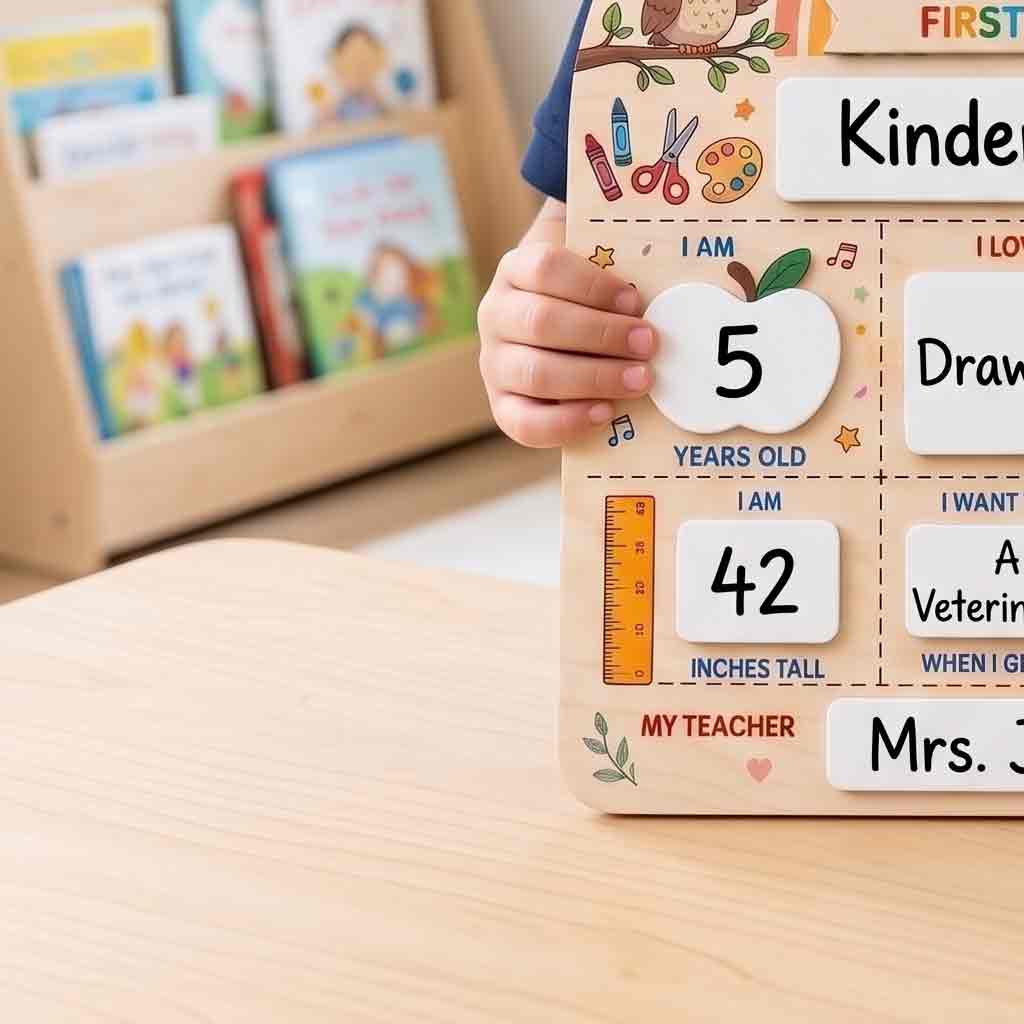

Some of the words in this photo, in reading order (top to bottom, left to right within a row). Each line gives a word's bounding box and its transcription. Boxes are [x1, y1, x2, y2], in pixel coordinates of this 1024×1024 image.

[921, 5, 1024, 39] FIRST
[682, 236, 687, 256] I
[697, 236, 734, 257] AM
[977, 236, 982, 257] I
[716, 324, 762, 398] 5
[674, 446, 750, 466] YEARS
[759, 446, 806, 466] OLD
[739, 492, 742, 511] I
[748, 492, 781, 511] AM
[942, 493, 947, 512] I
[953, 493, 1018, 512] WANT
[995, 539, 1019, 575] A
[711, 546, 799, 616] 42
[692, 659, 770, 678] INCHES
[776, 659, 825, 678] TALL
[922, 654, 985, 673] WHEN
[991, 655, 996, 673] I
[641, 715, 677, 736] MY
[683, 715, 795, 737] TEACHER
[871, 716, 986, 773] Mrs.
